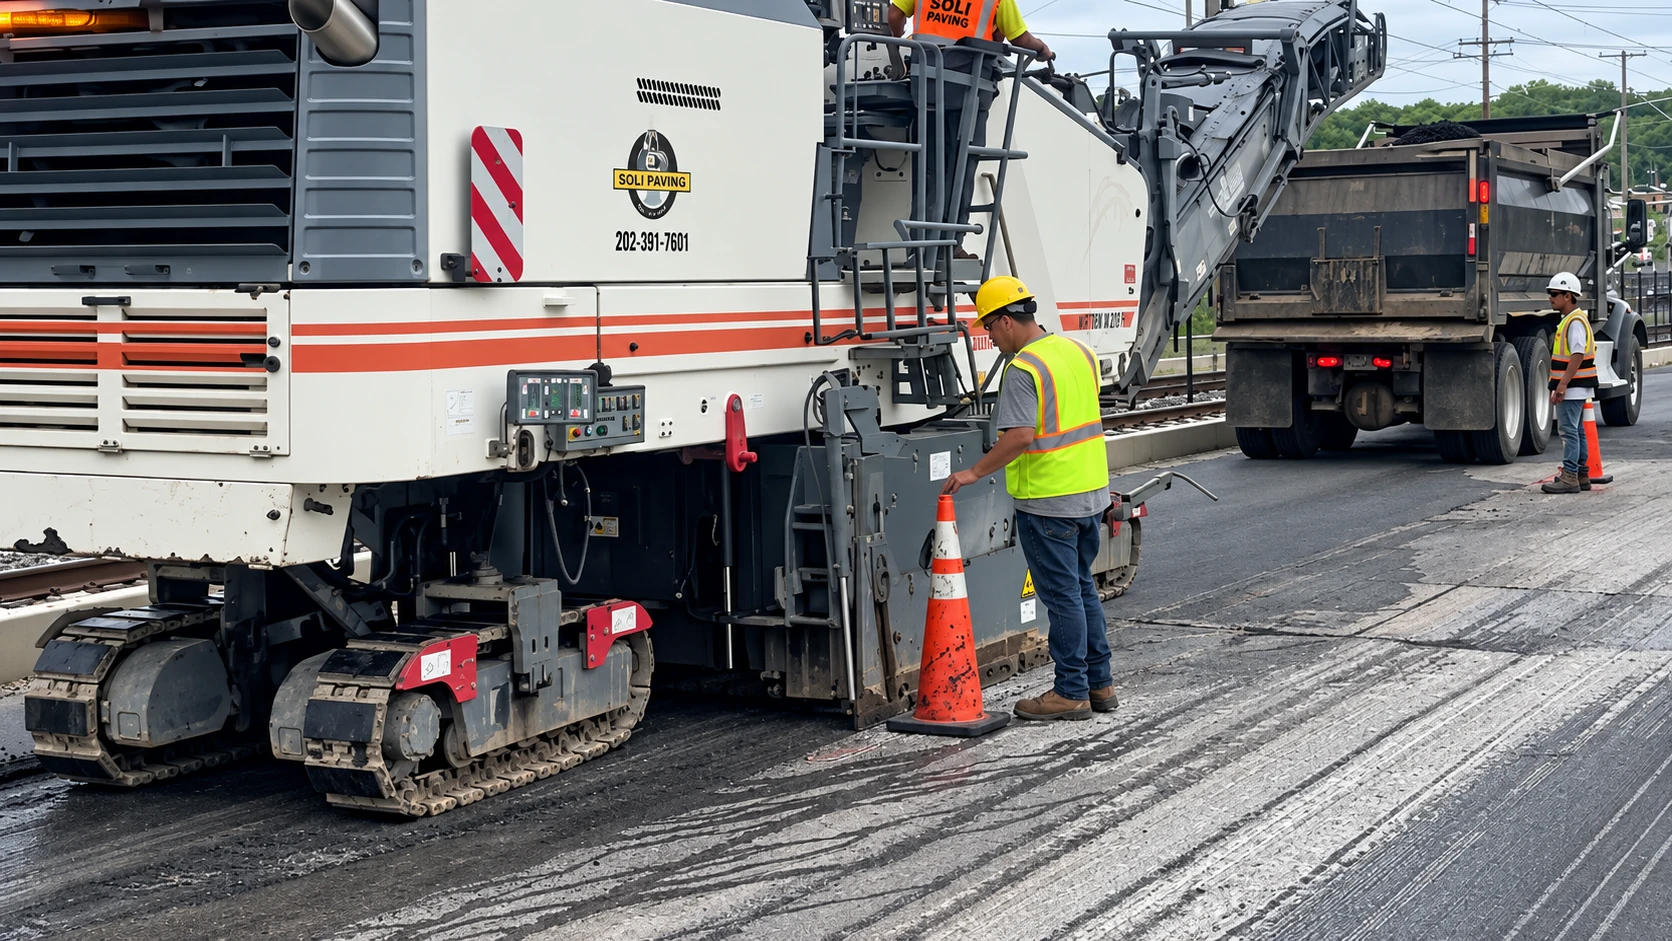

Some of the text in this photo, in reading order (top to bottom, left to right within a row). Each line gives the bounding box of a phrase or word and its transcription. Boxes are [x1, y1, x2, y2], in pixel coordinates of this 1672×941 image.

[930, 0, 972, 16] SOLI
[926, 11, 969, 29] PAVING
[618, 173, 686, 188] SOLI PAVING
[615, 230, 689, 252] 202-391-7601
